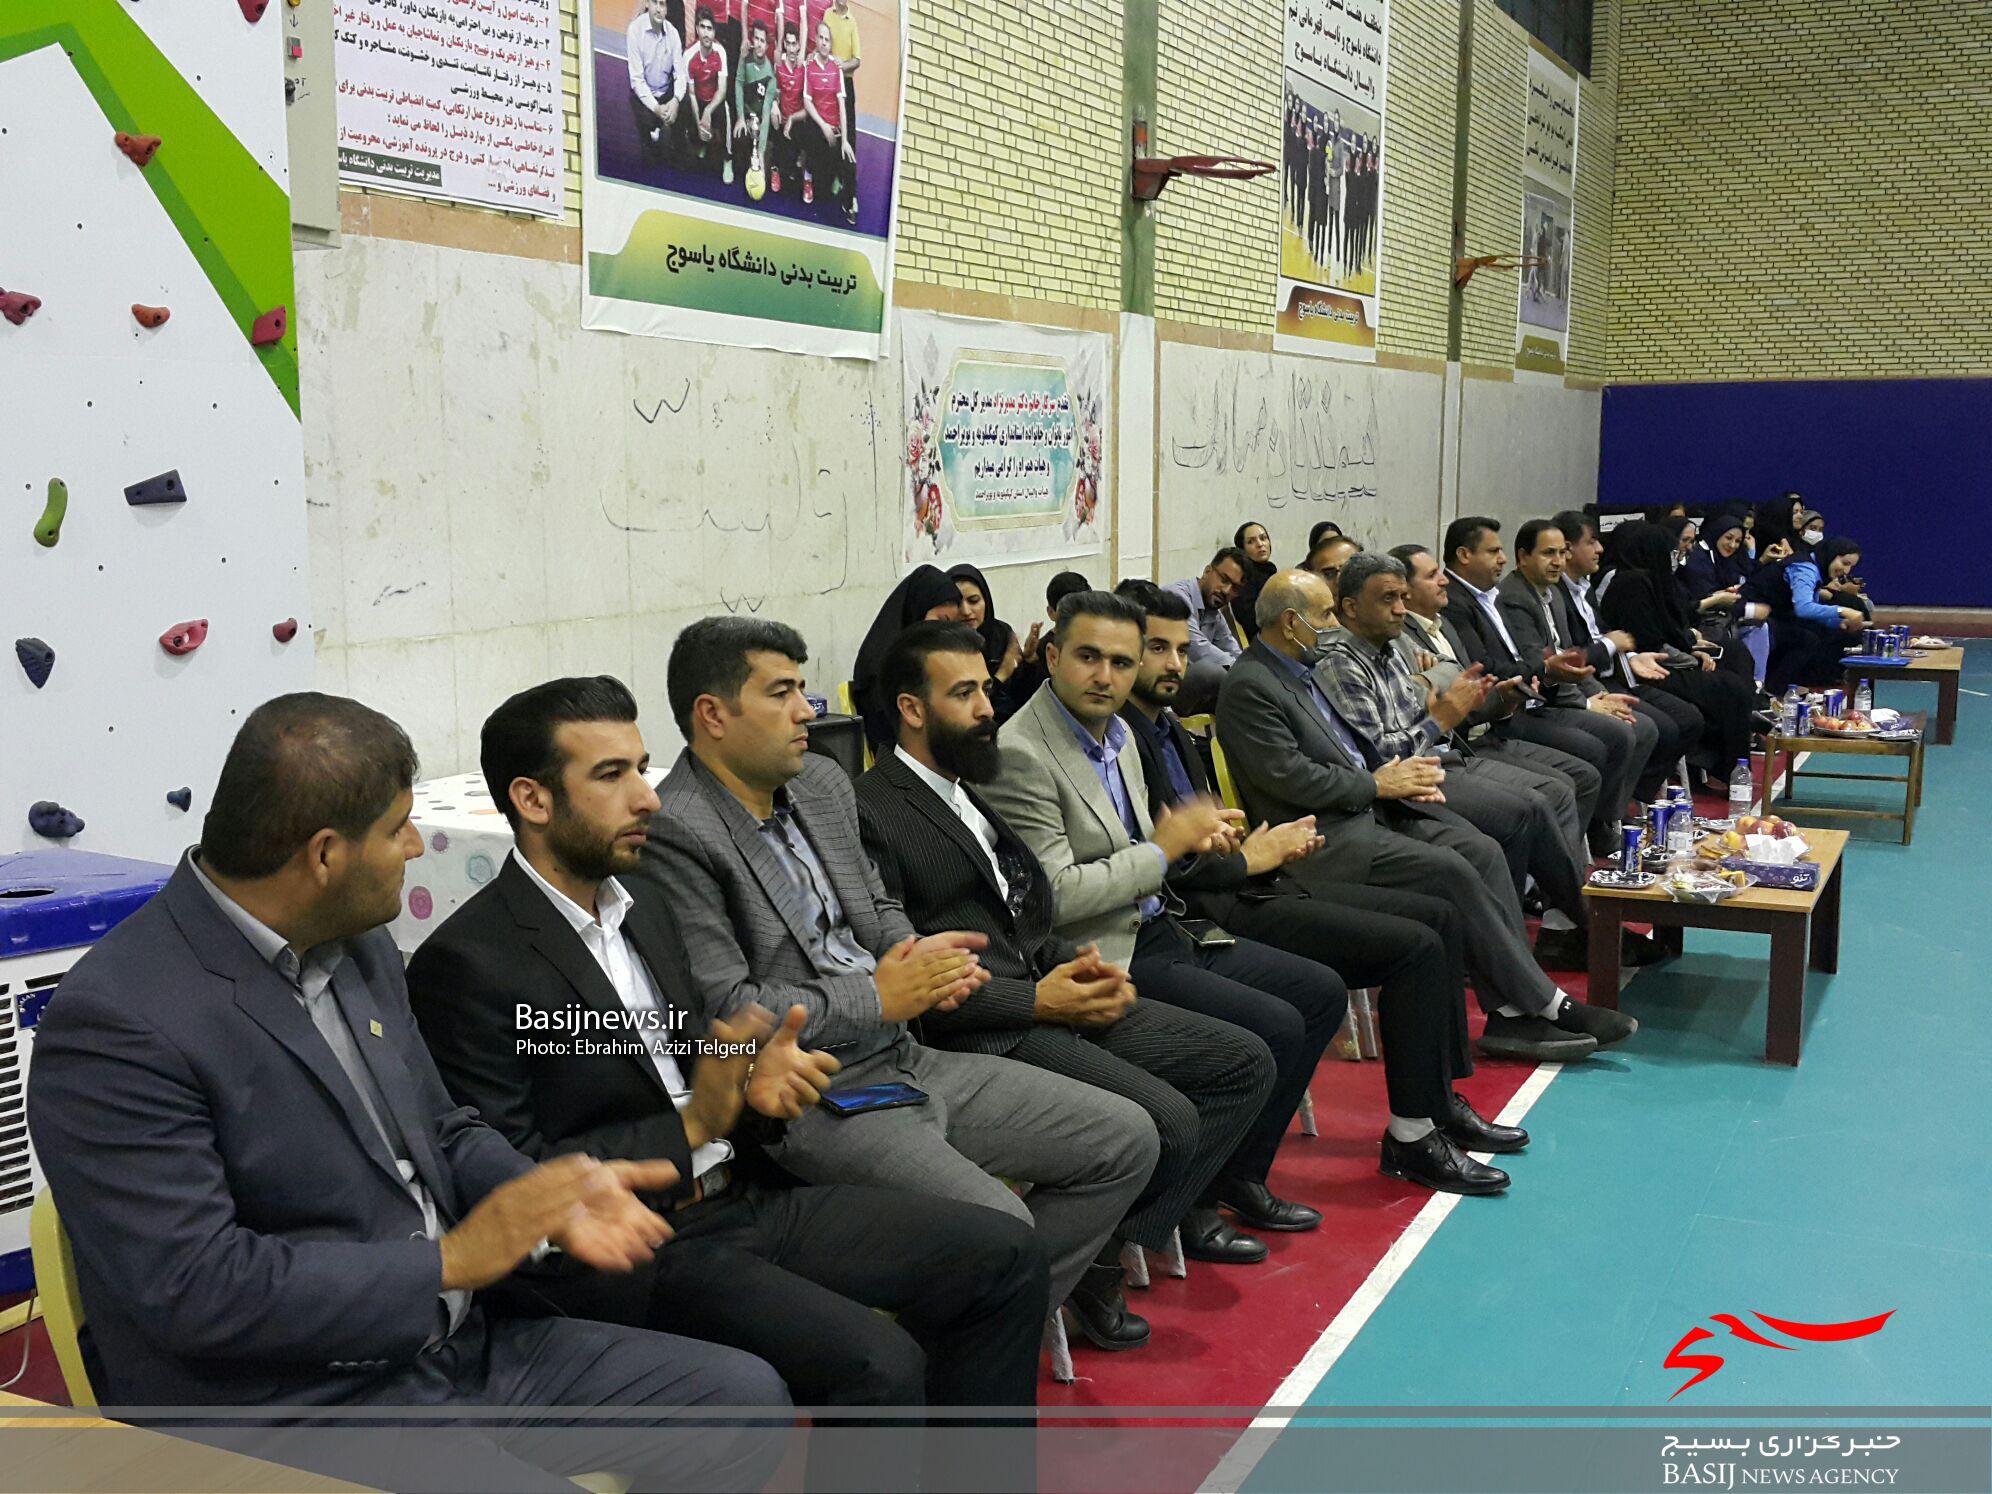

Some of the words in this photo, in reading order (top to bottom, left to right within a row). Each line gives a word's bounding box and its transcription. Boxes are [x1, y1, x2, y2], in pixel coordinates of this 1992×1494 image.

[344, 9, 355, 22] غیر
[358, 10, 375, 29] رفتار
[382, 17, 396, 31] عمل
[496, 29, 514, 42] توهین
[1341, 36, 1345, 51] و
[495, 48, 517, 63] تحریک
[1295, 41, 1322, 72] یاسوج
[1346, 37, 1361, 60] یاسوج
[1363, 42, 1381, 66] دانشگاه
[1324, 53, 1353, 82] دانشگاه
[338, 79, 355, 94] برای
[356, 83, 375, 99] بدنی
[450, 83, 479, 100] ورزشی
[1354, 69, 1374, 100] والیبال
[375, 88, 395, 103] تربیت
[481, 87, 503, 103] محیط
[339, 126, 346, 141] از
[347, 129, 380, 146] محرومیت
[415, 141, 438, 159] پرونده
[349, 153, 375, 169] دانشگاه
[376, 159, 393, 174] بدنی
[394, 163, 413, 178] تربیت
[414, 165, 440, 181] مدیریت
[666, 244, 714, 274] یاسوج
[718, 246, 777, 277] دانشگاه
[781, 263, 813, 289] بدنی
[816, 269, 857, 295] تربیت
[1298, 300, 1314, 321] یاسوج
[1314, 300, 1333, 317] دانشگاه
[1333, 307, 1344, 322] بدنی
[1345, 309, 1359, 325] تربیت
